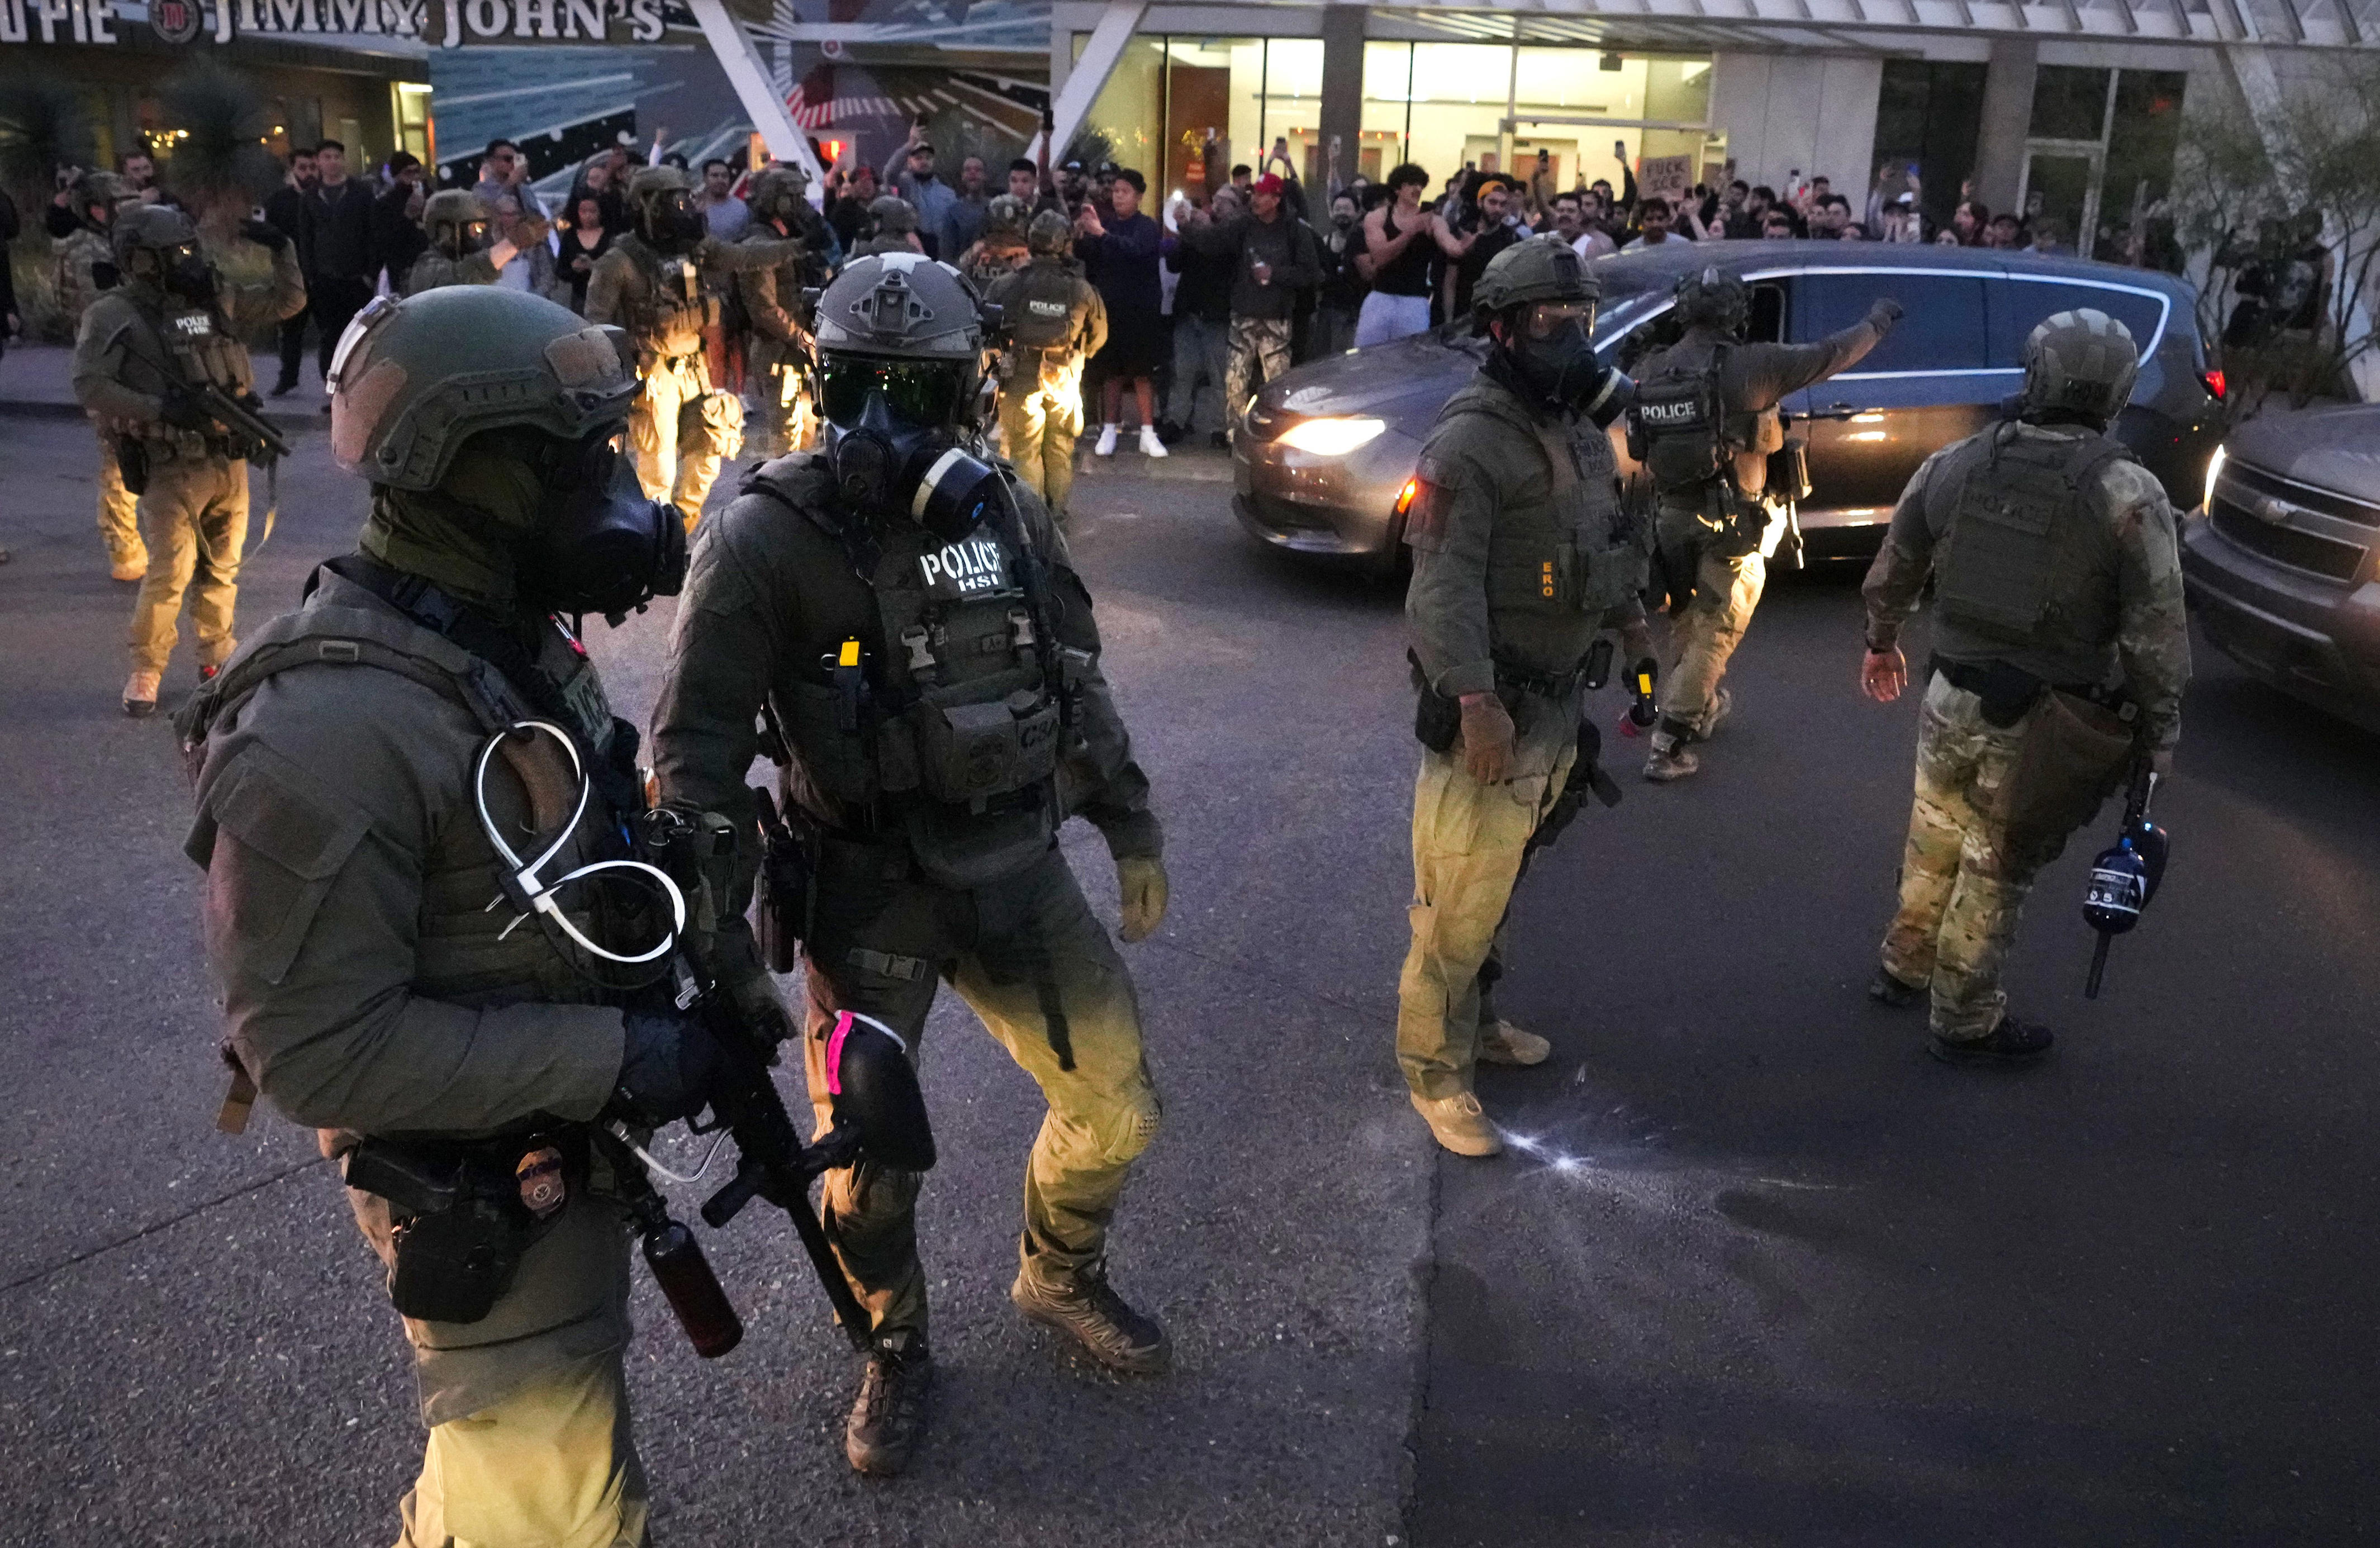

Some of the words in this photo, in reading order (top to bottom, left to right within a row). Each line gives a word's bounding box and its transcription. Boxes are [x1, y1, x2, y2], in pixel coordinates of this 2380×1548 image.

[39, 0, 117, 43] PIE
[215, 0, 419, 43] JIMMY
[443, 0, 664, 48] JOHN'S
[1646, 161, 1685, 177] FUCK
[1650, 175, 1681, 192] ICE
[1029, 300, 1066, 313] POLICE
[1641, 401, 1697, 420] POLICE
[919, 541, 1003, 587] POLICE
[958, 573, 999, 592] HSI
[1542, 562, 1555, 597] ERO
